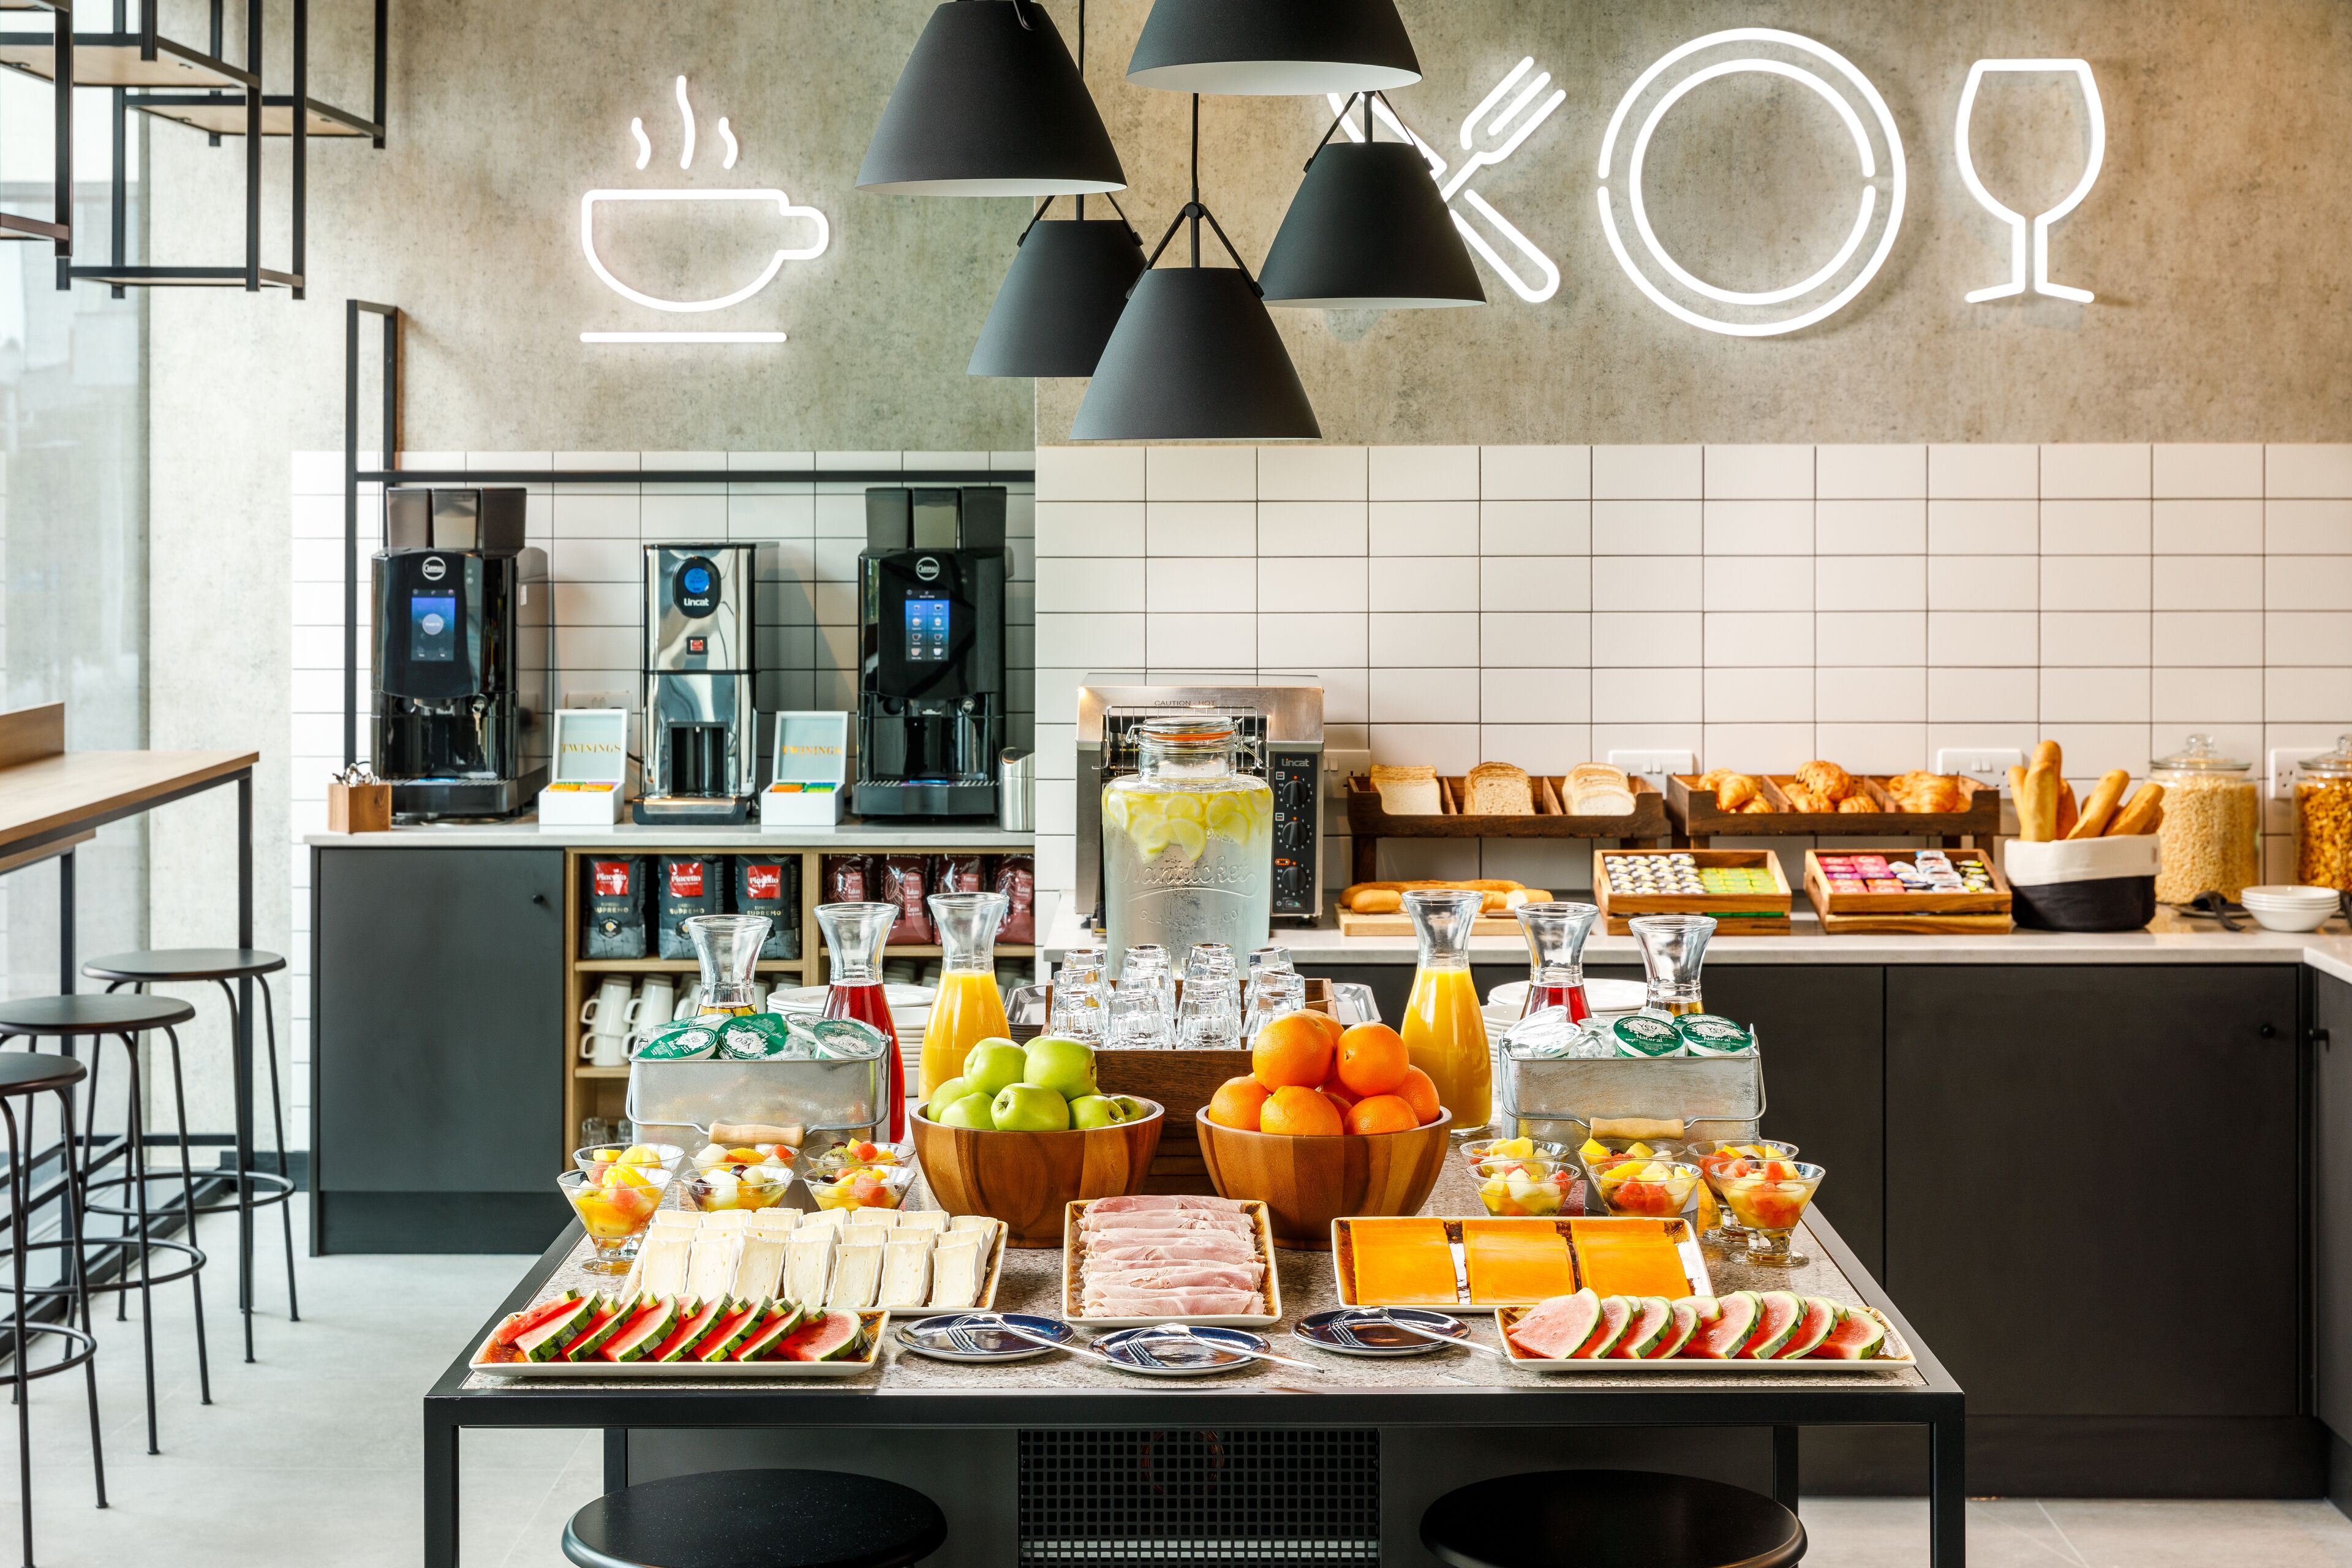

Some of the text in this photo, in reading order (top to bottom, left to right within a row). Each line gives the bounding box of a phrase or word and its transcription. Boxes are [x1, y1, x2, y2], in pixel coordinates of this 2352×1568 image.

[562, 743, 620, 753] TWININGS
[782, 745, 842, 755] TWININGS
[834, 1028, 861, 1038] Natural
[1636, 1035, 1663, 1043] Natural
